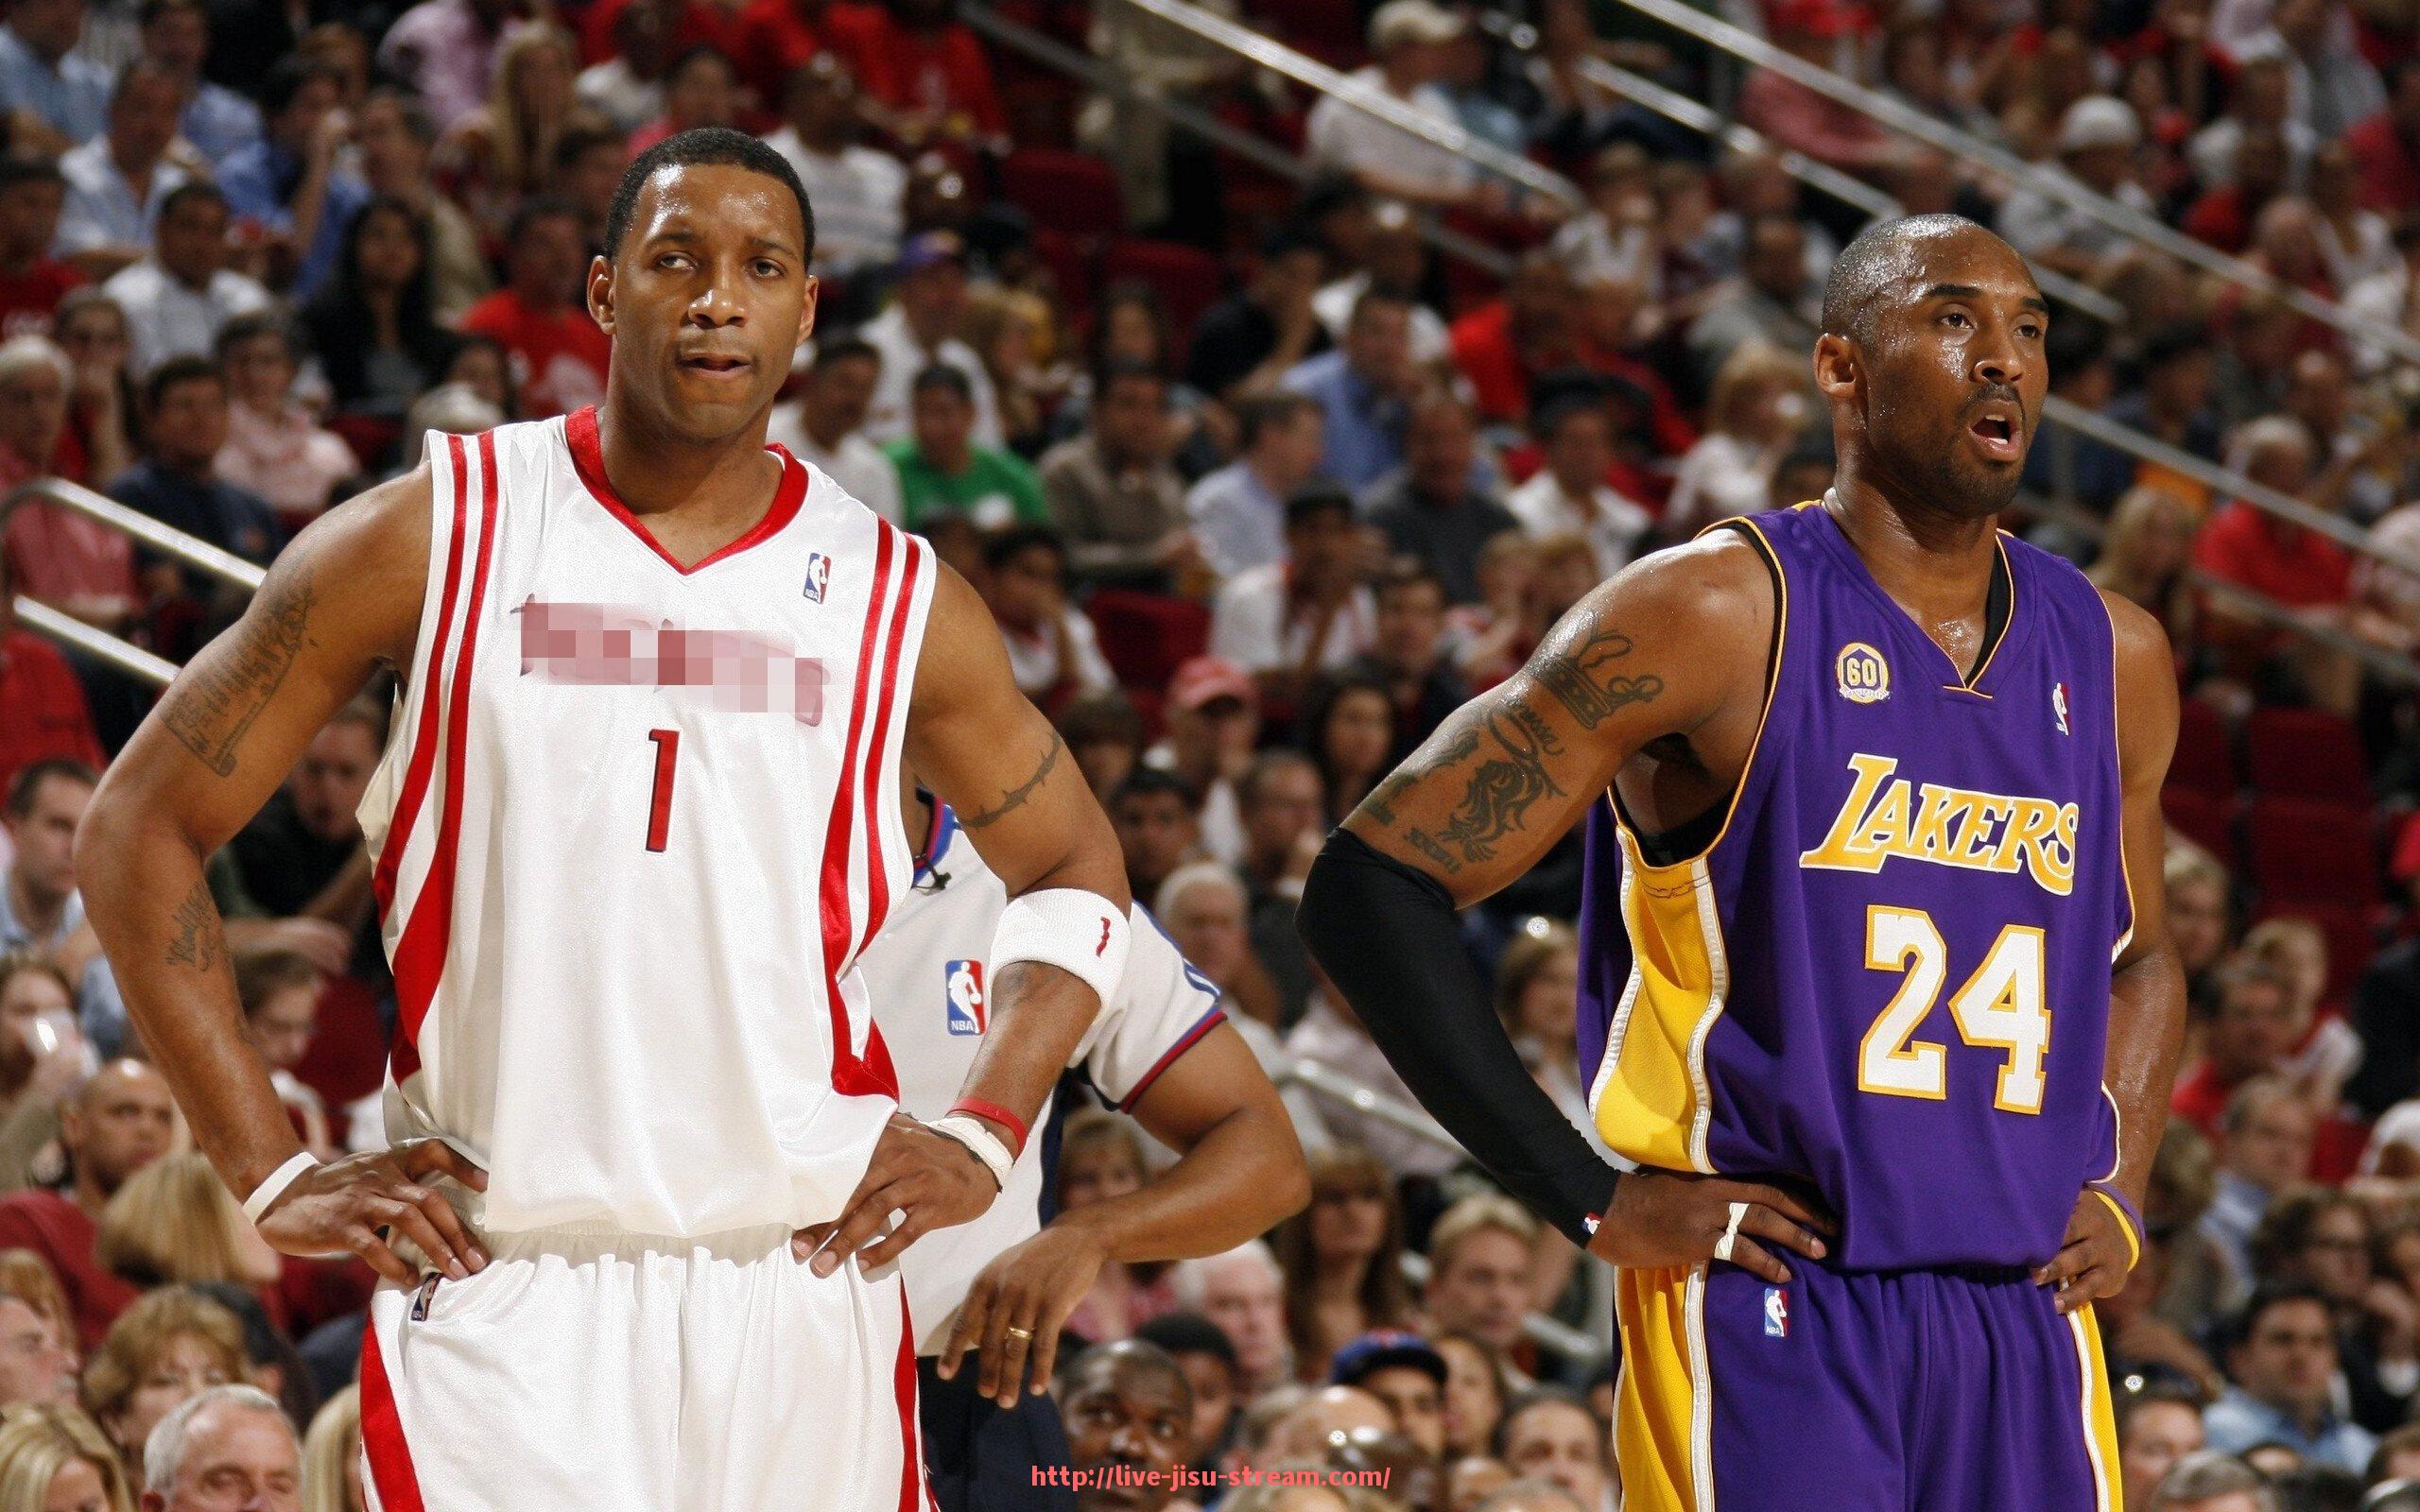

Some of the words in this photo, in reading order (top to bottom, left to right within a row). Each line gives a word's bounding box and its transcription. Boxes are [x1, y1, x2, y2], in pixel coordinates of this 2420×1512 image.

[1846, 657, 1877, 687] 60
[646, 729, 680, 852] 1
[1799, 752, 2079, 896] LAKERS
[950, 1020, 975, 1031] NBA
[1858, 903, 2052, 1115] 24
